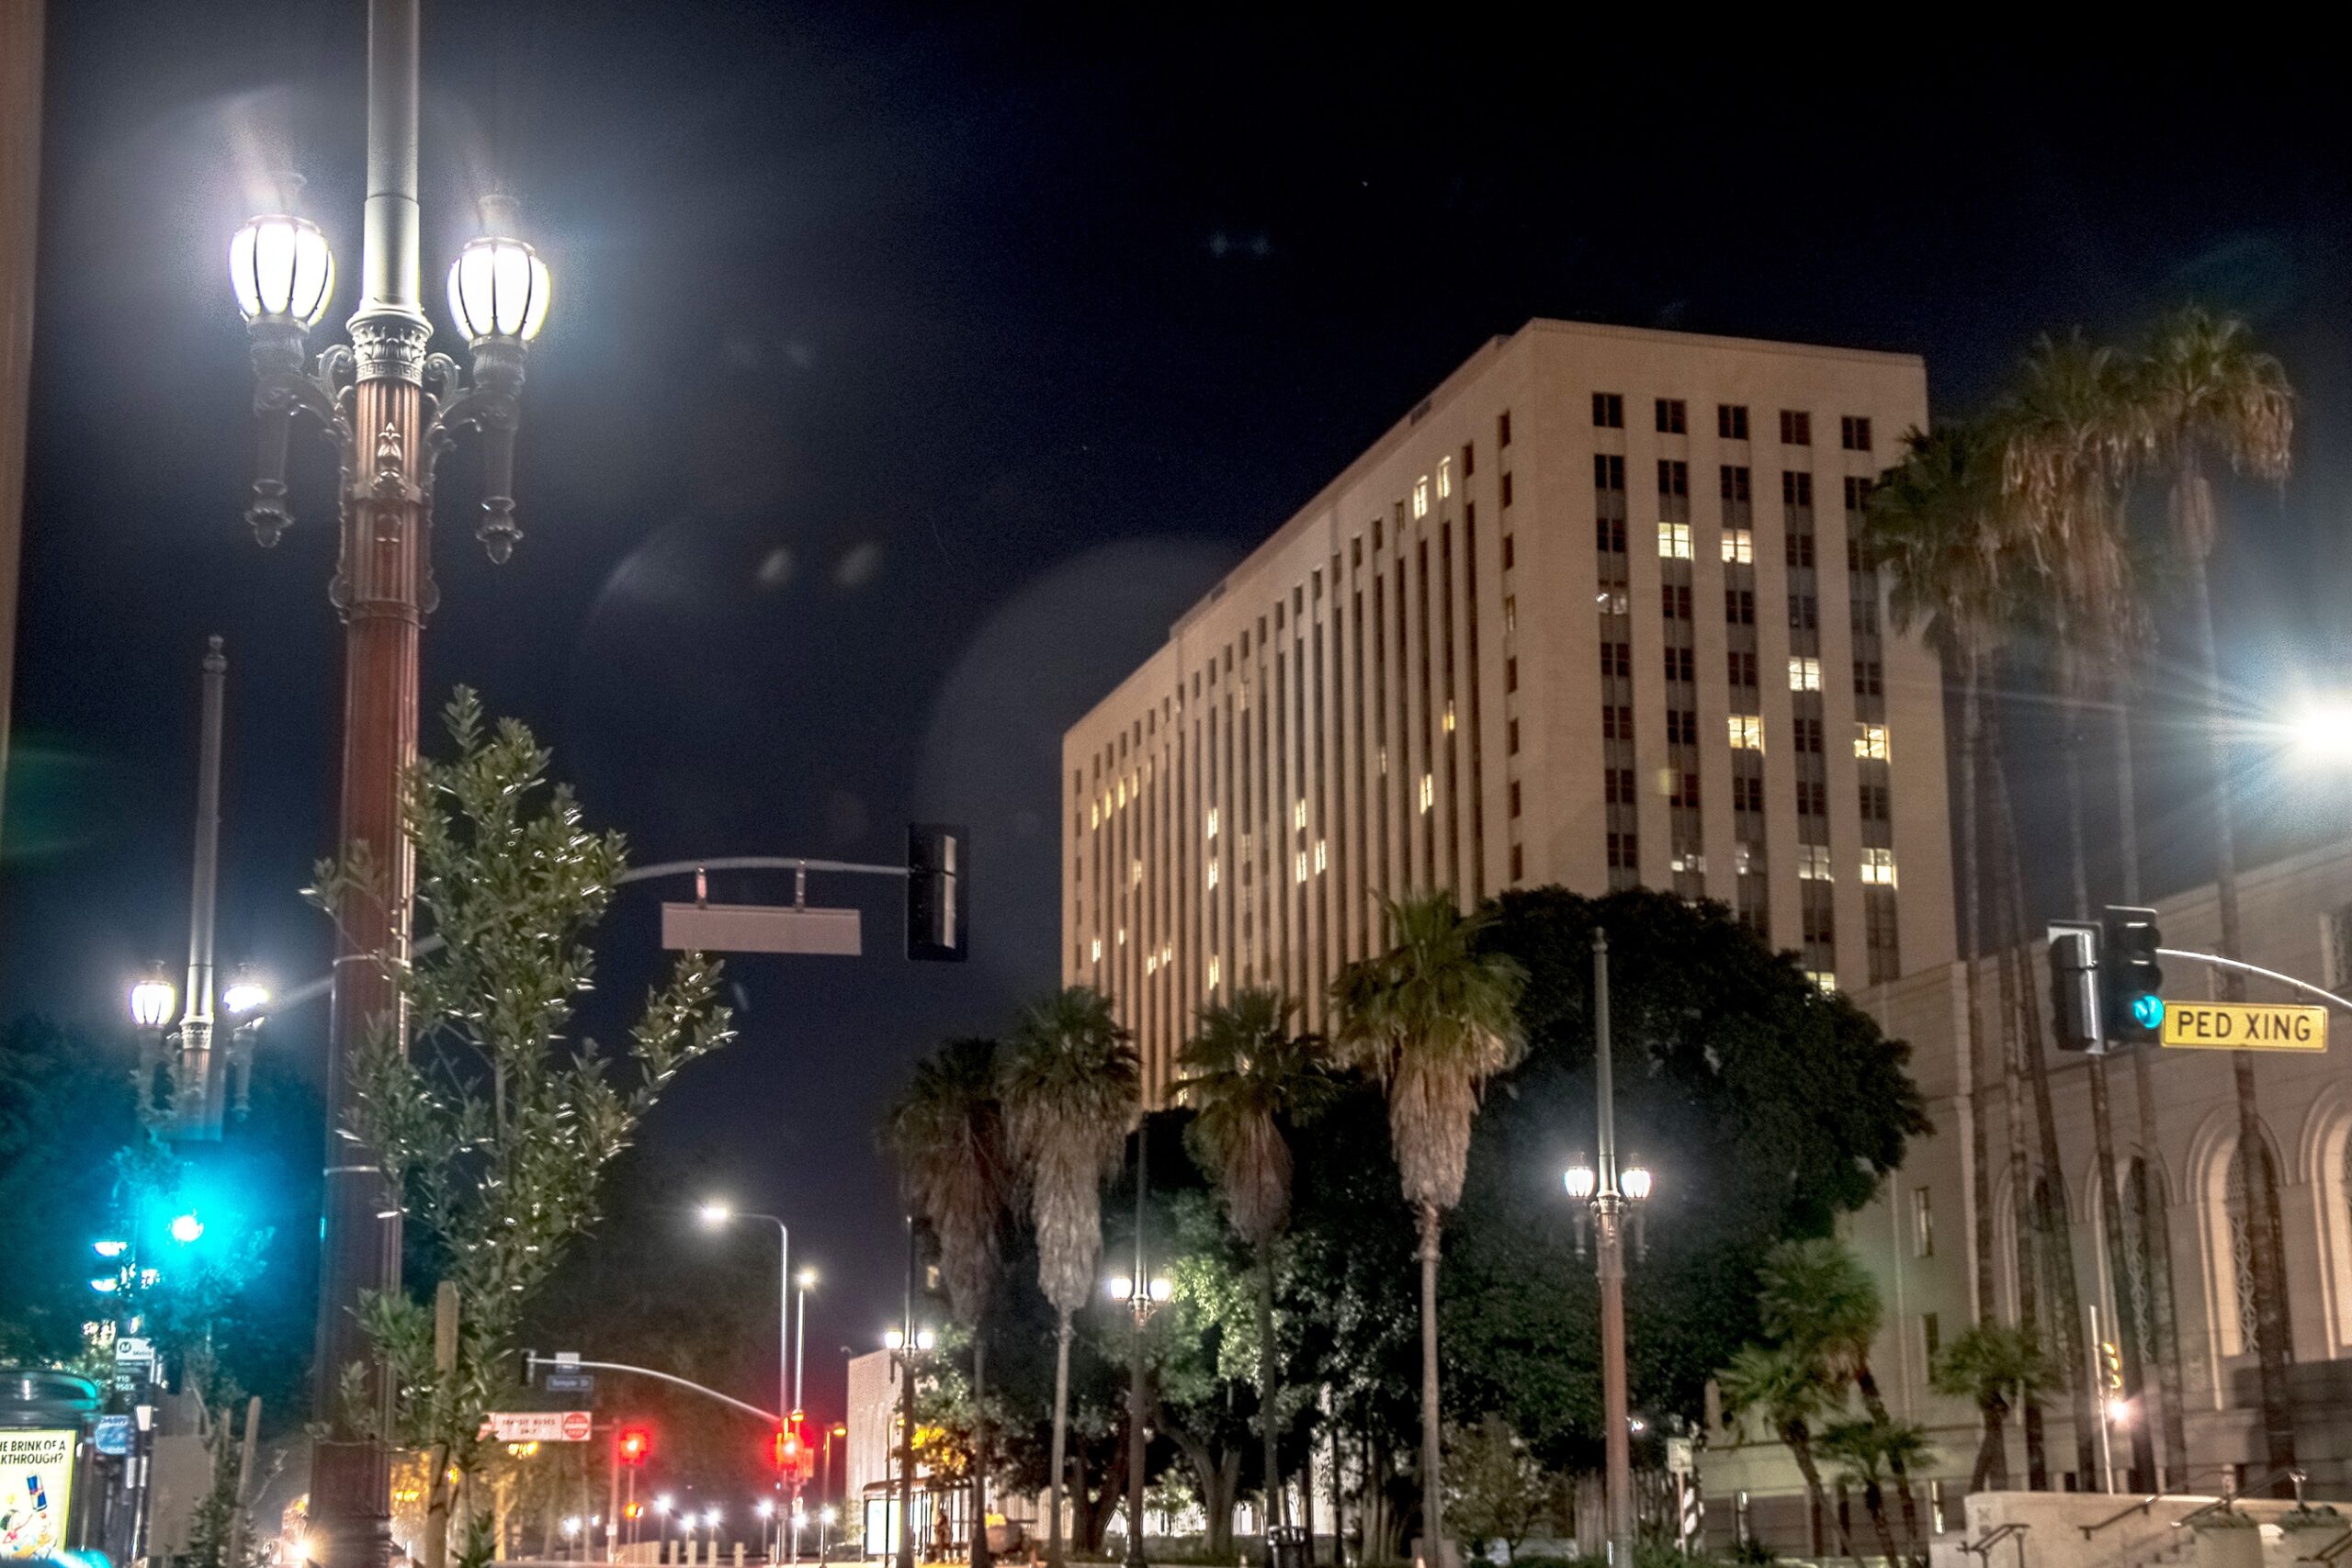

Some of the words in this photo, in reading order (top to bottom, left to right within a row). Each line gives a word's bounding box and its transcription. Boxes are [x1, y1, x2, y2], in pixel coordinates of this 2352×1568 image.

[2177, 1011, 2232, 1038] PED
[2245, 1013, 2311, 1042] XING
[11, 1440, 42, 1451] BRINK
[43, 1439, 57, 1450] OF
[59, 1440, 65, 1450] A
